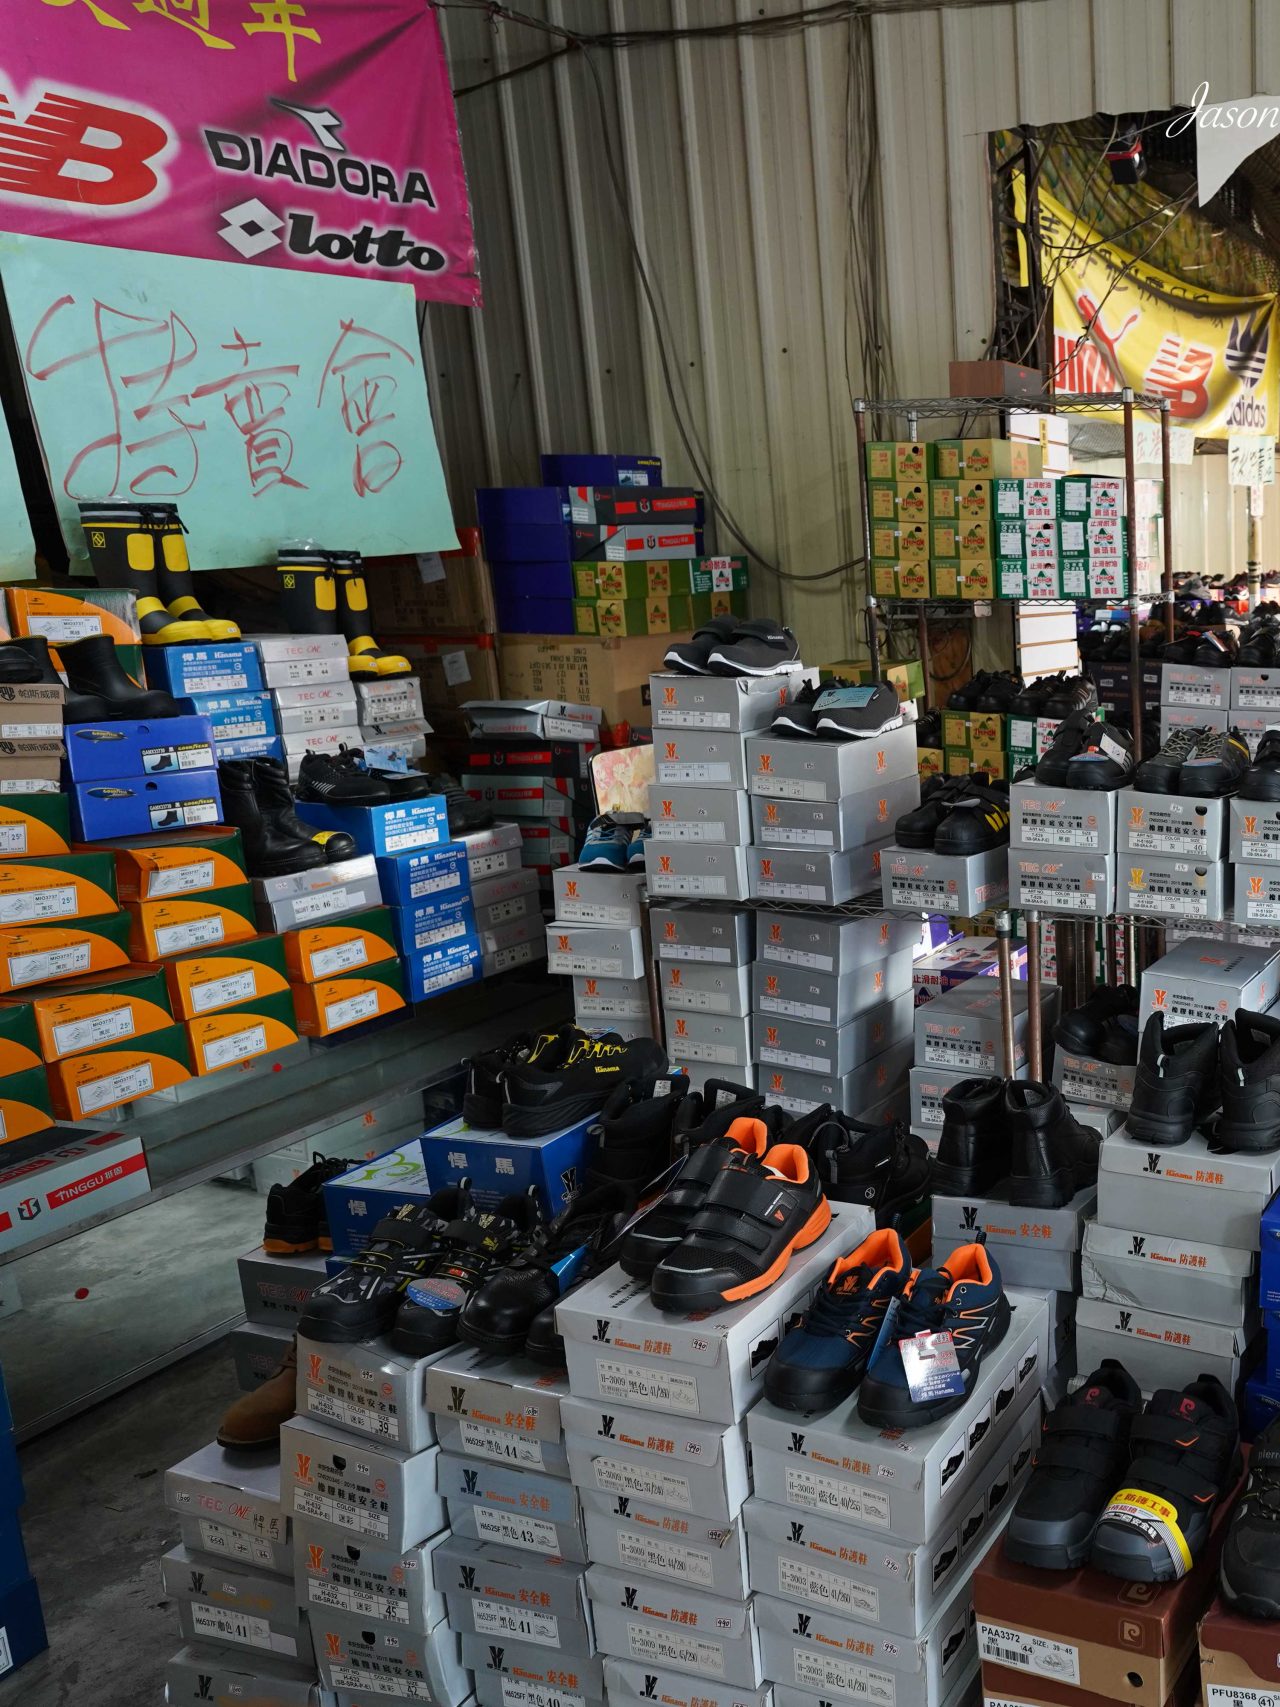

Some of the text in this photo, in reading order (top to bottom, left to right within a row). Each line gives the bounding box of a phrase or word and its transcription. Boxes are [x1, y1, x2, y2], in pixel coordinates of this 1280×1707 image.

[204, 129, 436, 208] DIADORA
[288, 213, 445, 271] lotto
[1195, 1170, 1224, 1185] 防護鞋
[56, 1175, 103, 1200] TINGGU
[1020, 1223, 1052, 1239] 安全鞋
[1179, 1253, 1207, 1268] 防護鞋
[1164, 1329, 1191, 1345] 防護鞋
[644, 1339, 672, 1356] 防護鞋
[378, 1420, 389, 1434] 39
[504, 1412, 537, 1431] 安全鞋
[647, 1436, 675, 1453] 防護鞋
[842, 1458, 871, 1475] 防護鞋
[838, 1548, 867, 1566] 防護鞋
[519, 1588, 551, 1607] 安全鞋
[670, 1608, 698, 1625] 防護鞋
[981, 1625, 1021, 1643] PAA3372
[1023, 1645, 1034, 1653] 44
[1212, 1688, 1257, 1700] PFU8368
